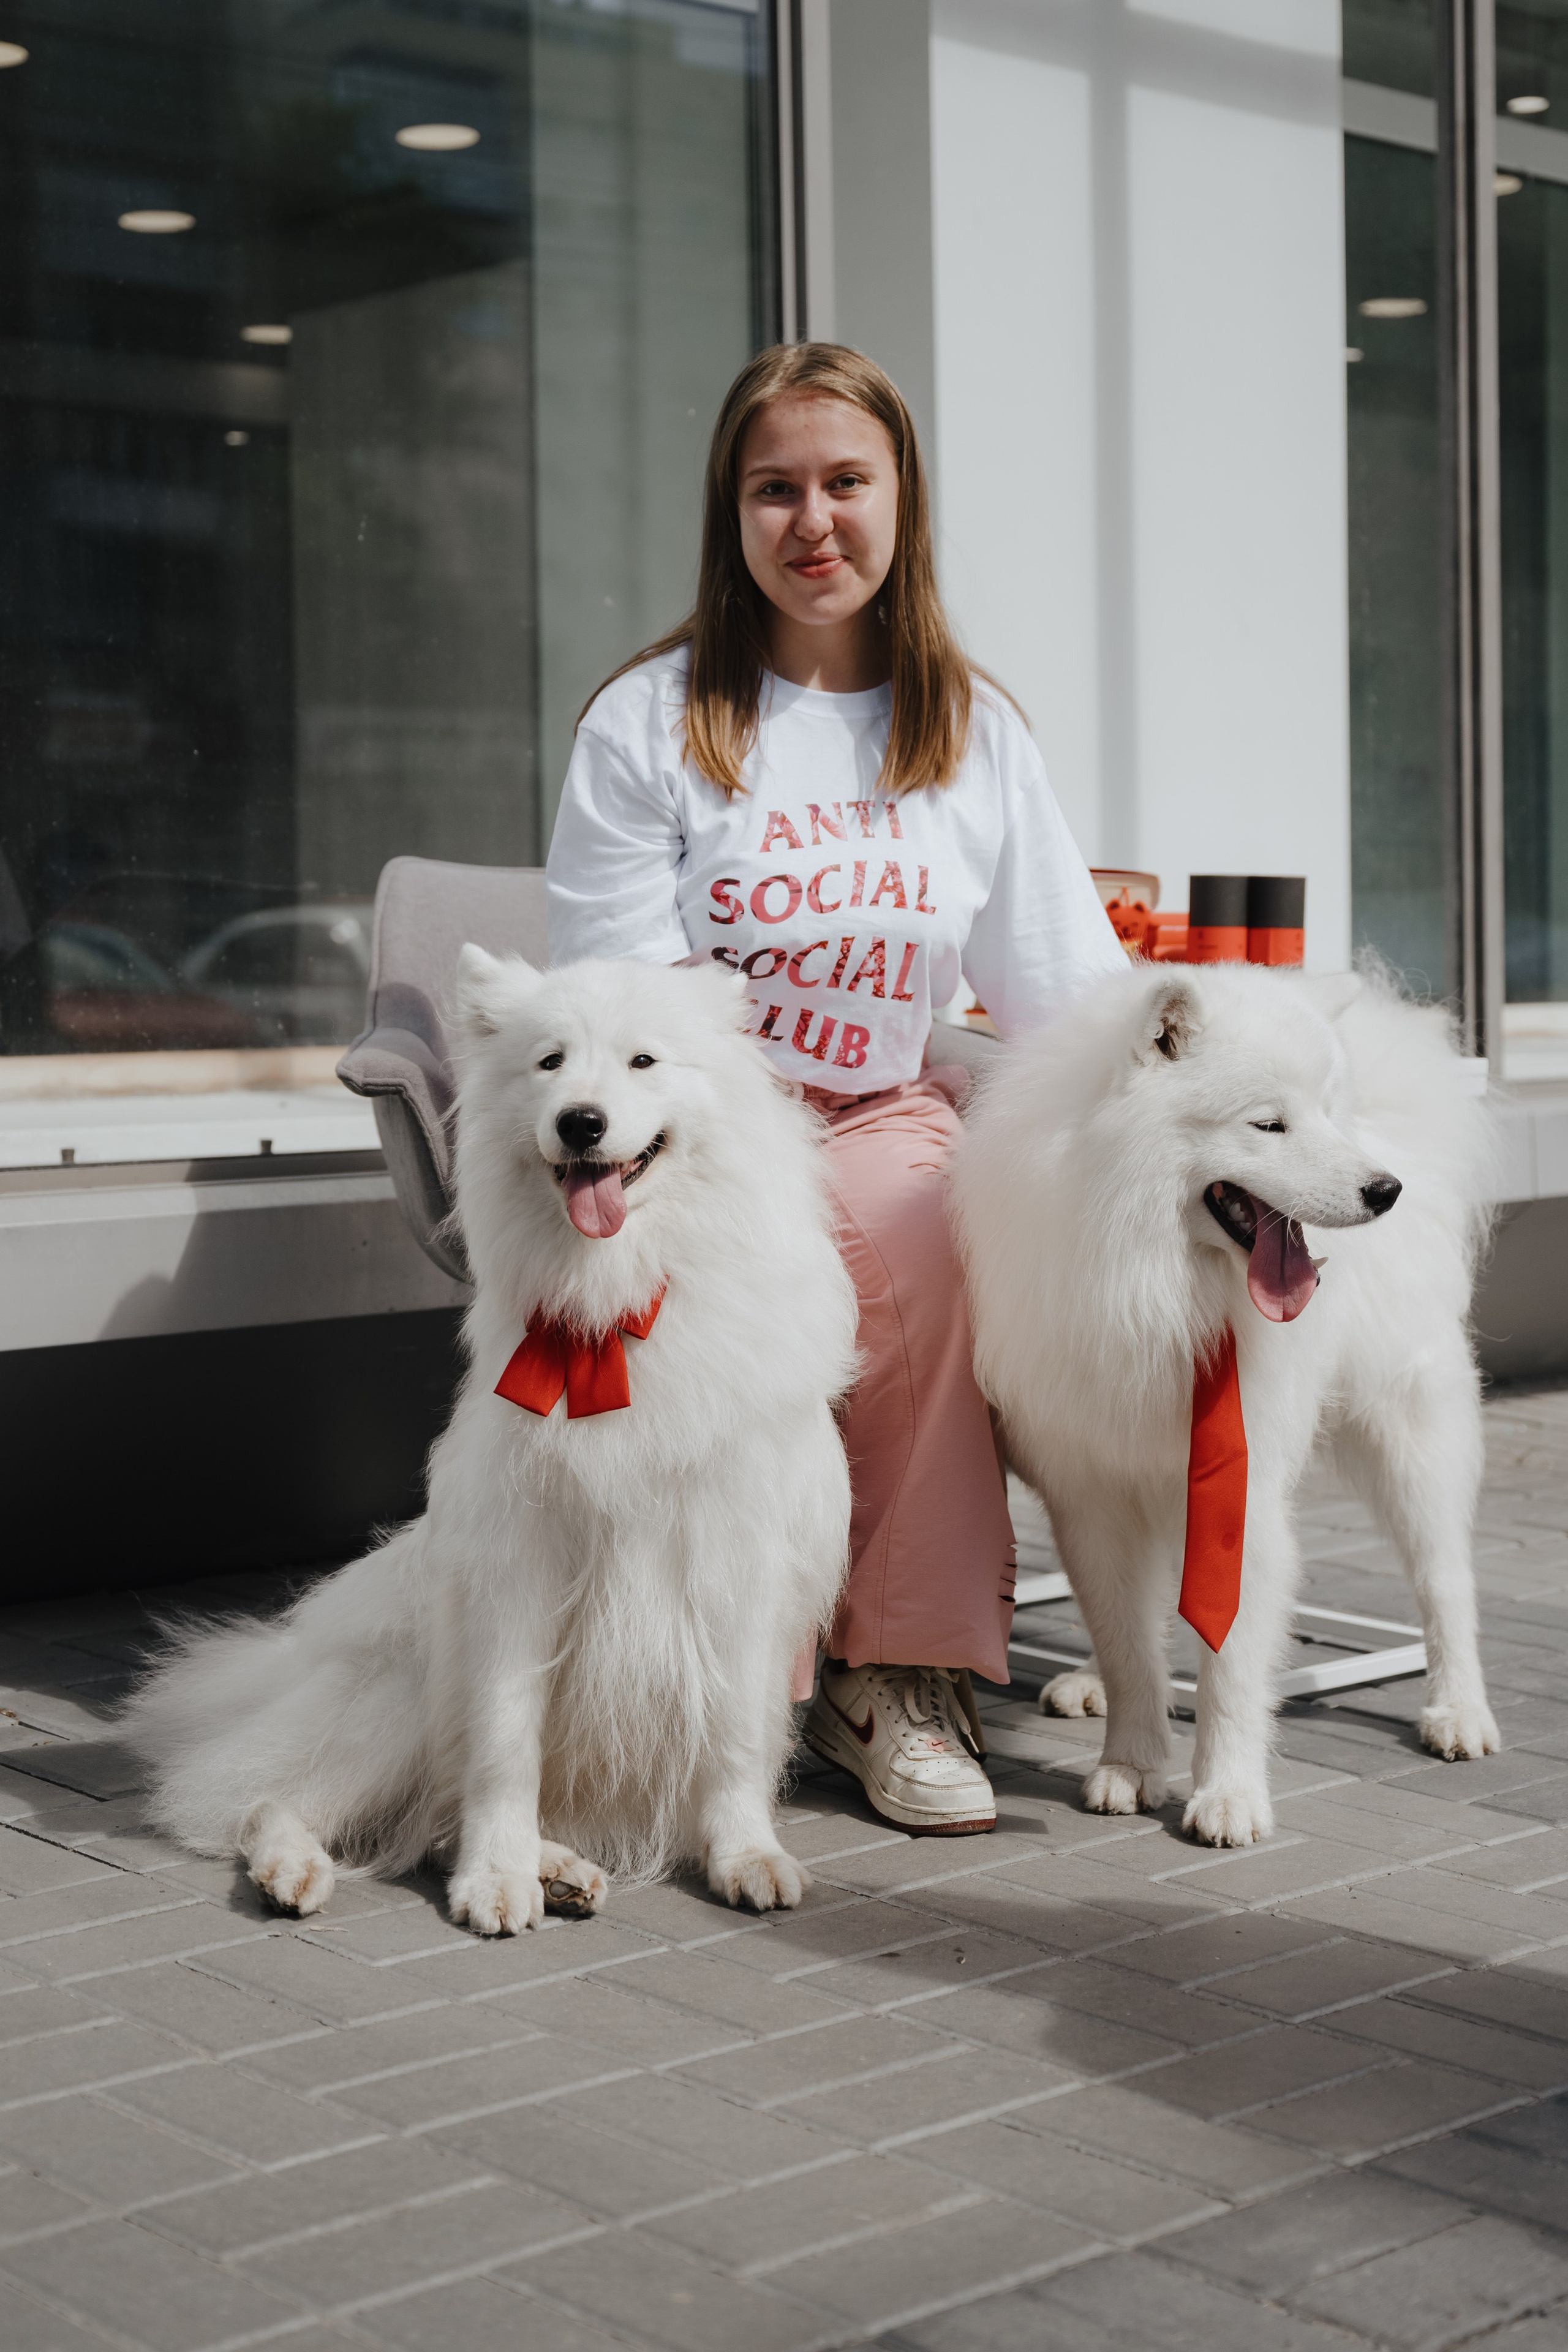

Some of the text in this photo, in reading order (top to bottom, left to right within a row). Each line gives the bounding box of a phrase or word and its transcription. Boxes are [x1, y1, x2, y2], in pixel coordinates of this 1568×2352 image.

[759, 800, 904, 853] ANTI
[709, 860, 937, 924] SOCIAL
[740, 998, 871, 1069] LUB
